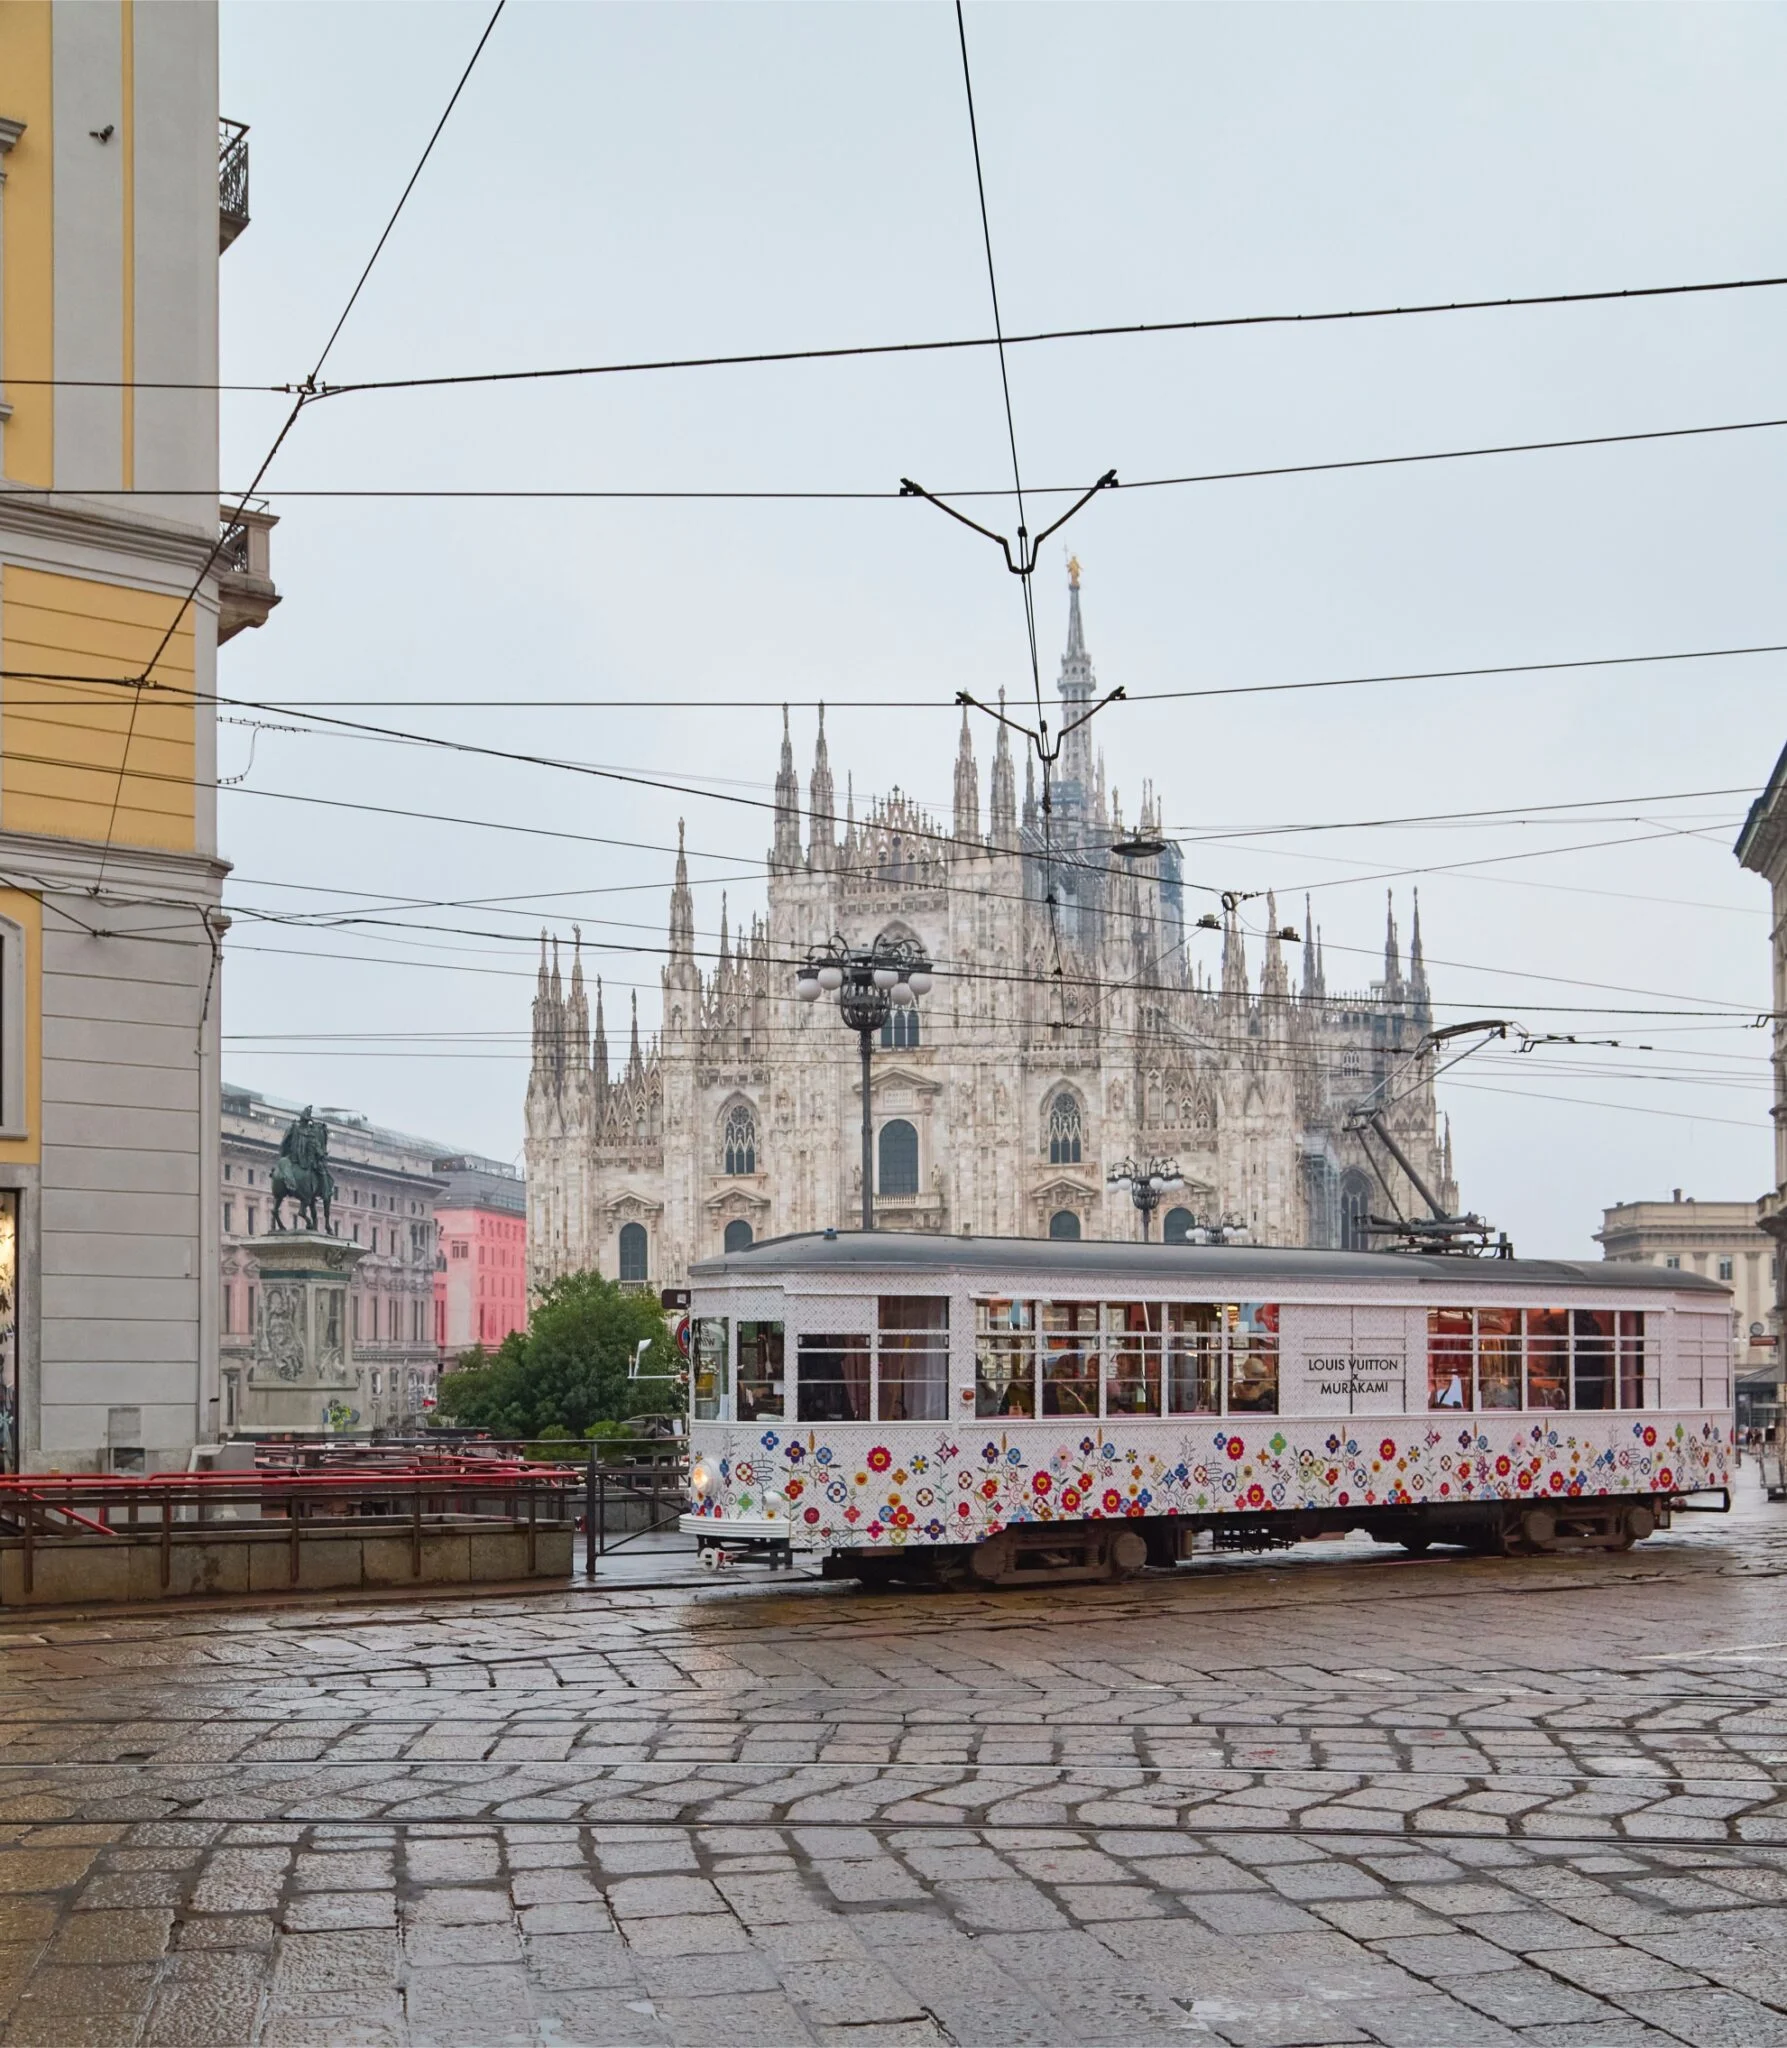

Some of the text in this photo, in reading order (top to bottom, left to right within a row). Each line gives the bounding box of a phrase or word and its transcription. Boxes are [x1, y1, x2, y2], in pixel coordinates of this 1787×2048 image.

[1308, 1359, 1398, 1371] LOUIS VUITTON
[1320, 1381, 1388, 1395] MURAKAMI
